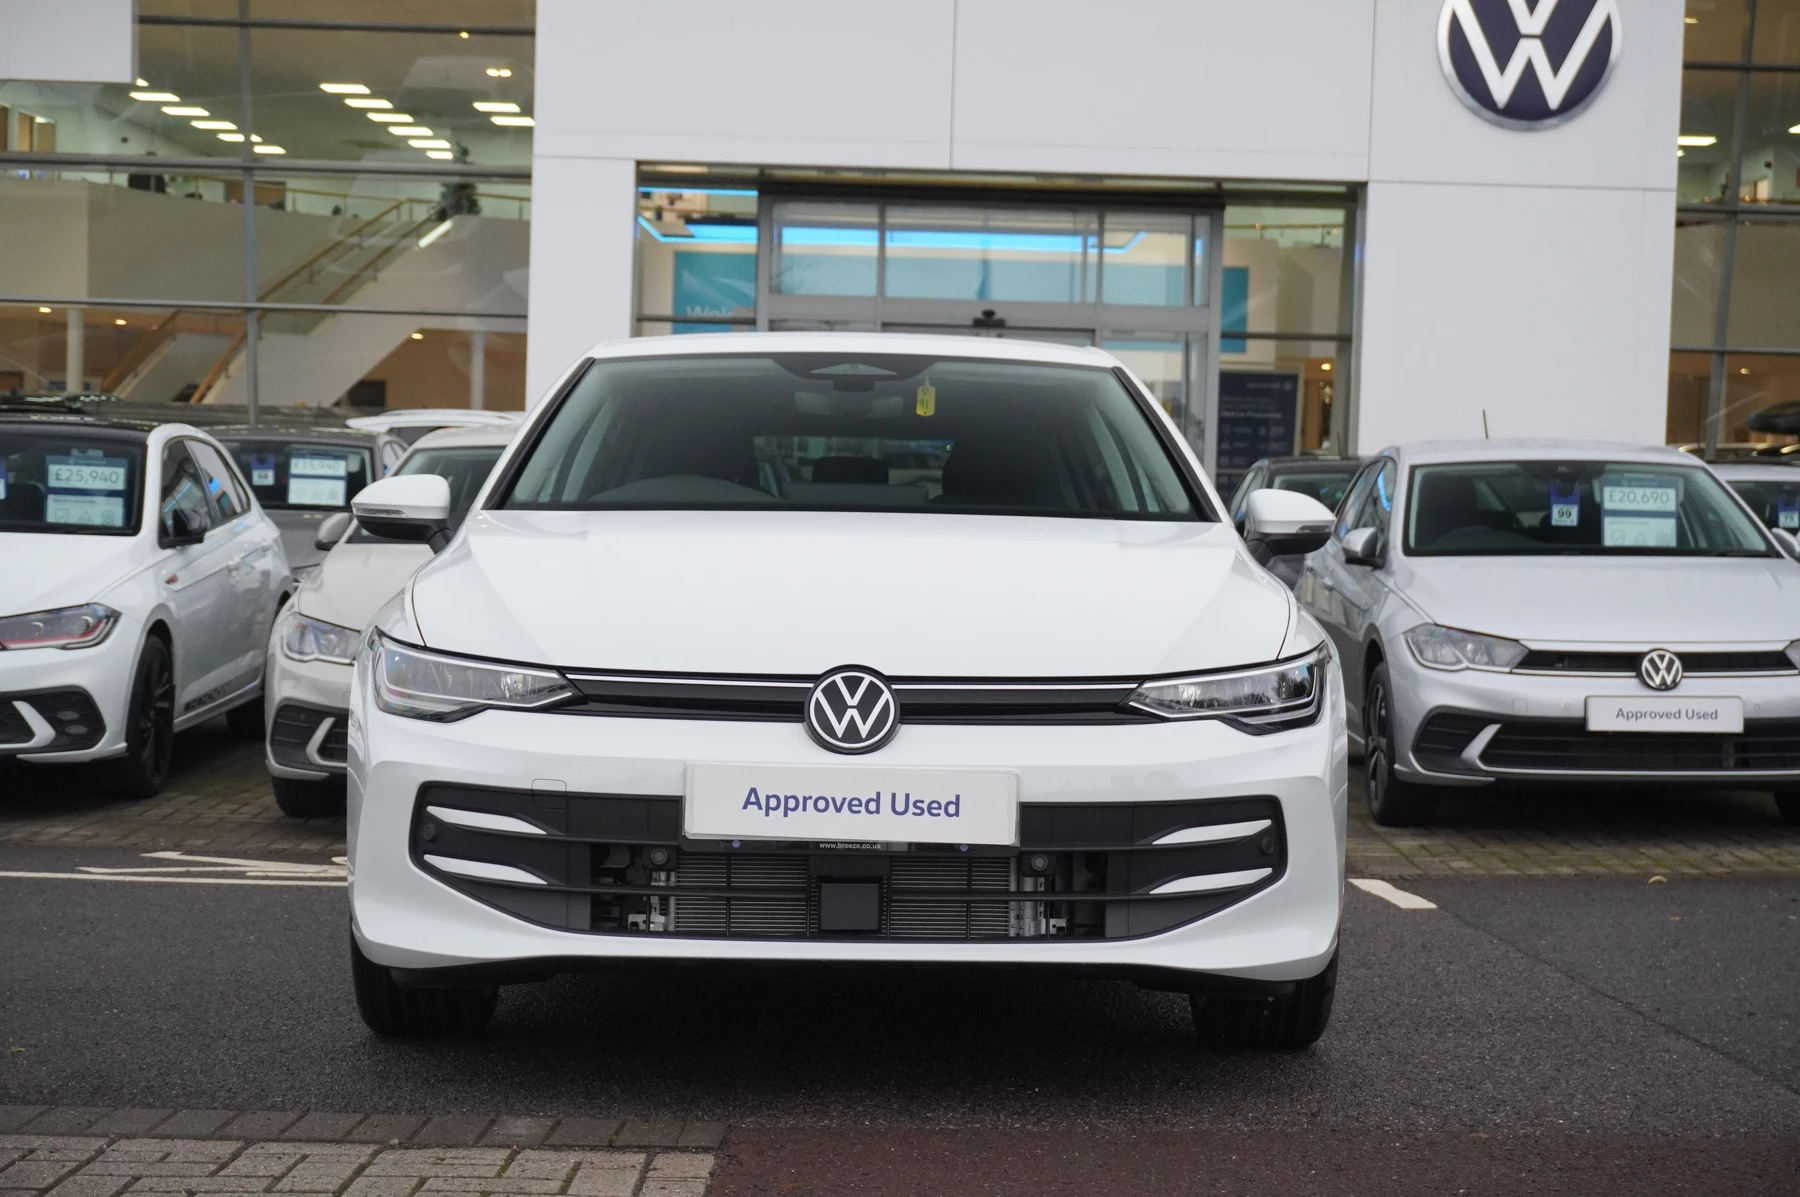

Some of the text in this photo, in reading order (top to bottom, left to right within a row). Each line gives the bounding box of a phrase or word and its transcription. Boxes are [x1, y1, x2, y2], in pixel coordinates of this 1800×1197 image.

[54, 467, 119, 485] £25,940
[1608, 489, 1670, 505] £20,690
[1557, 508, 1572, 519] 99
[1642, 650, 1682, 689] VW
[810, 672, 895, 748] VW
[1615, 708, 1718, 722] Approved Used
[741, 786, 961, 818] Approved Used
[818, 842, 882, 850] www.breeze.co.uk
